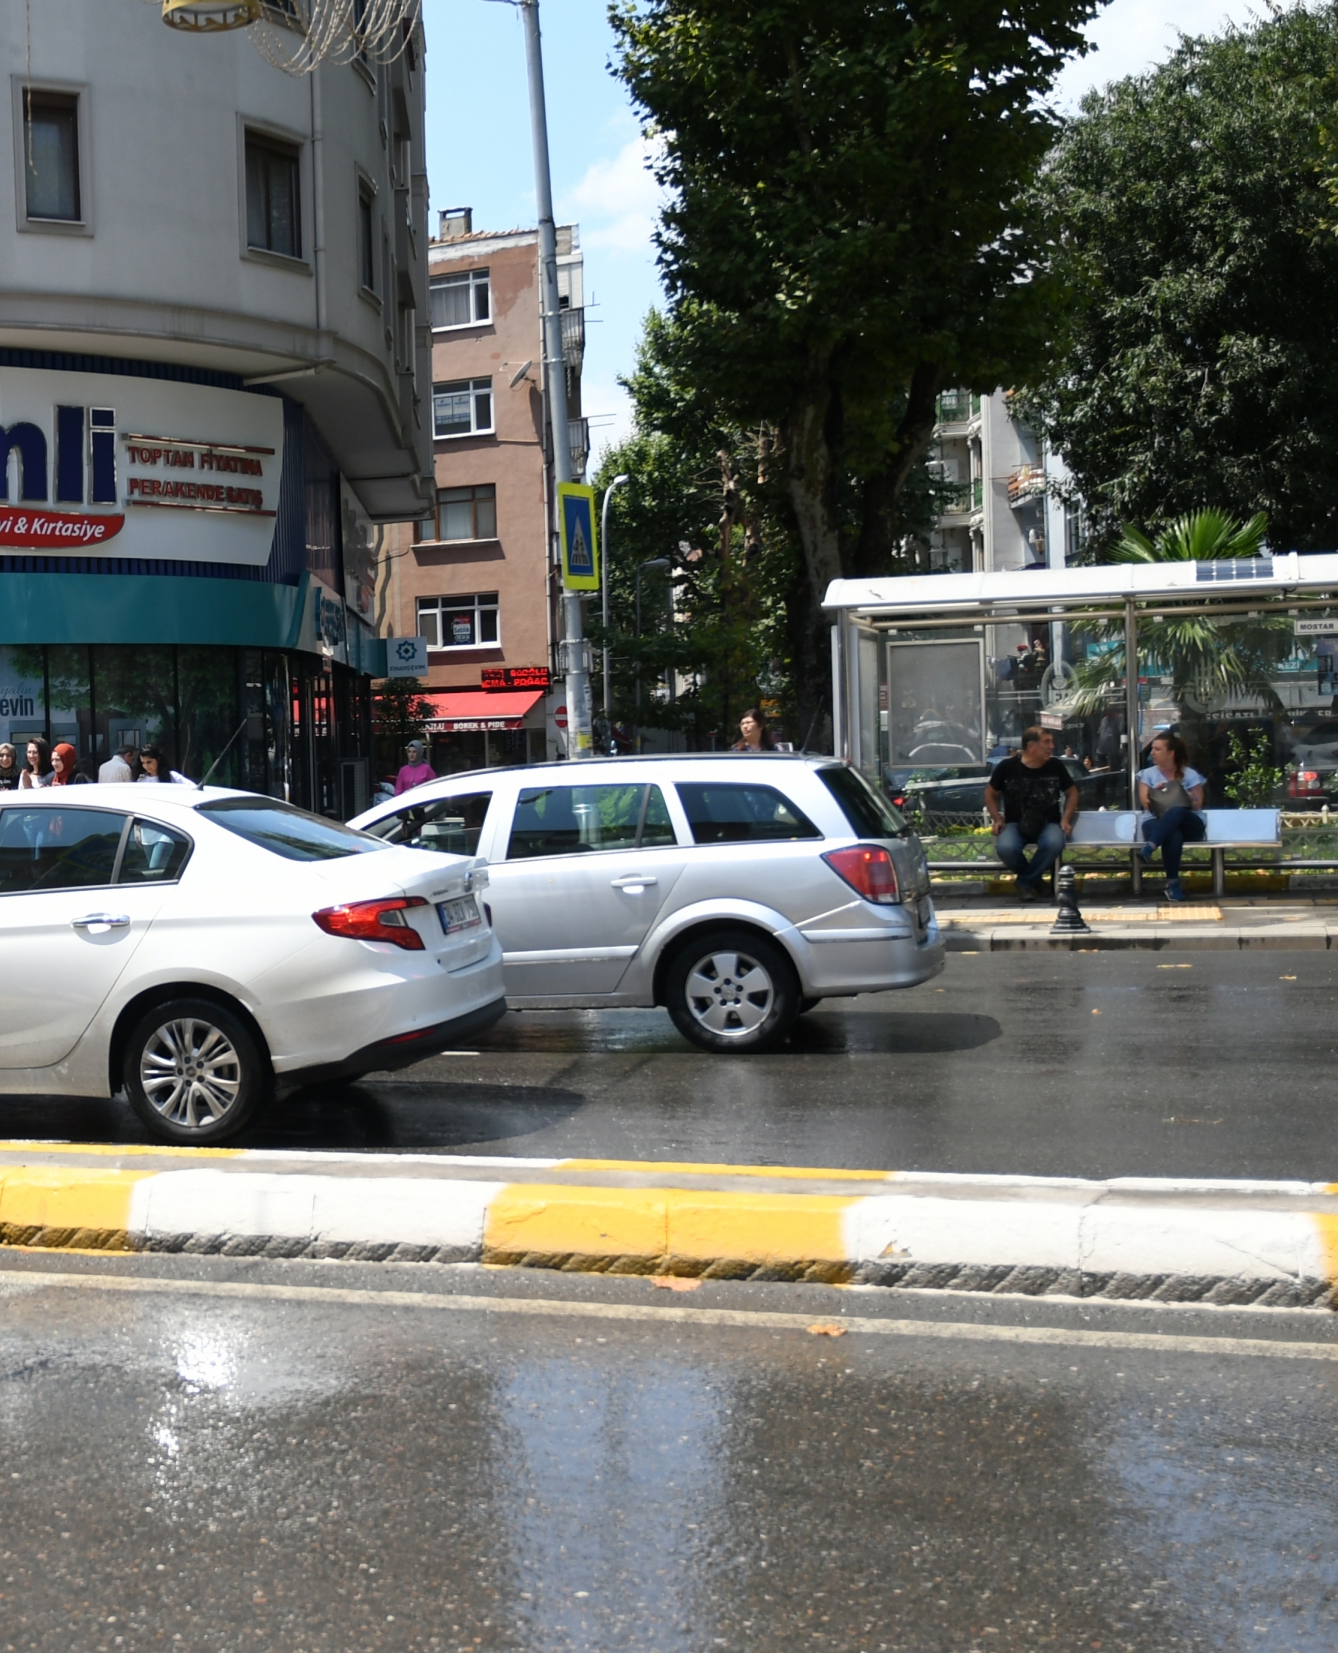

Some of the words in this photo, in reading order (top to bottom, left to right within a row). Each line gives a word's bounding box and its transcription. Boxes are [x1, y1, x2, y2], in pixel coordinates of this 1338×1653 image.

[128, 446, 194, 468] TOPTAN
[128, 478, 224, 502] PERAKENDE
[14, 516, 27, 534] &
[30, 517, 106, 542] Kırtasiye
[1299, 622, 1335, 631] MOSTAR
[0, 695, 34, 717] evin
